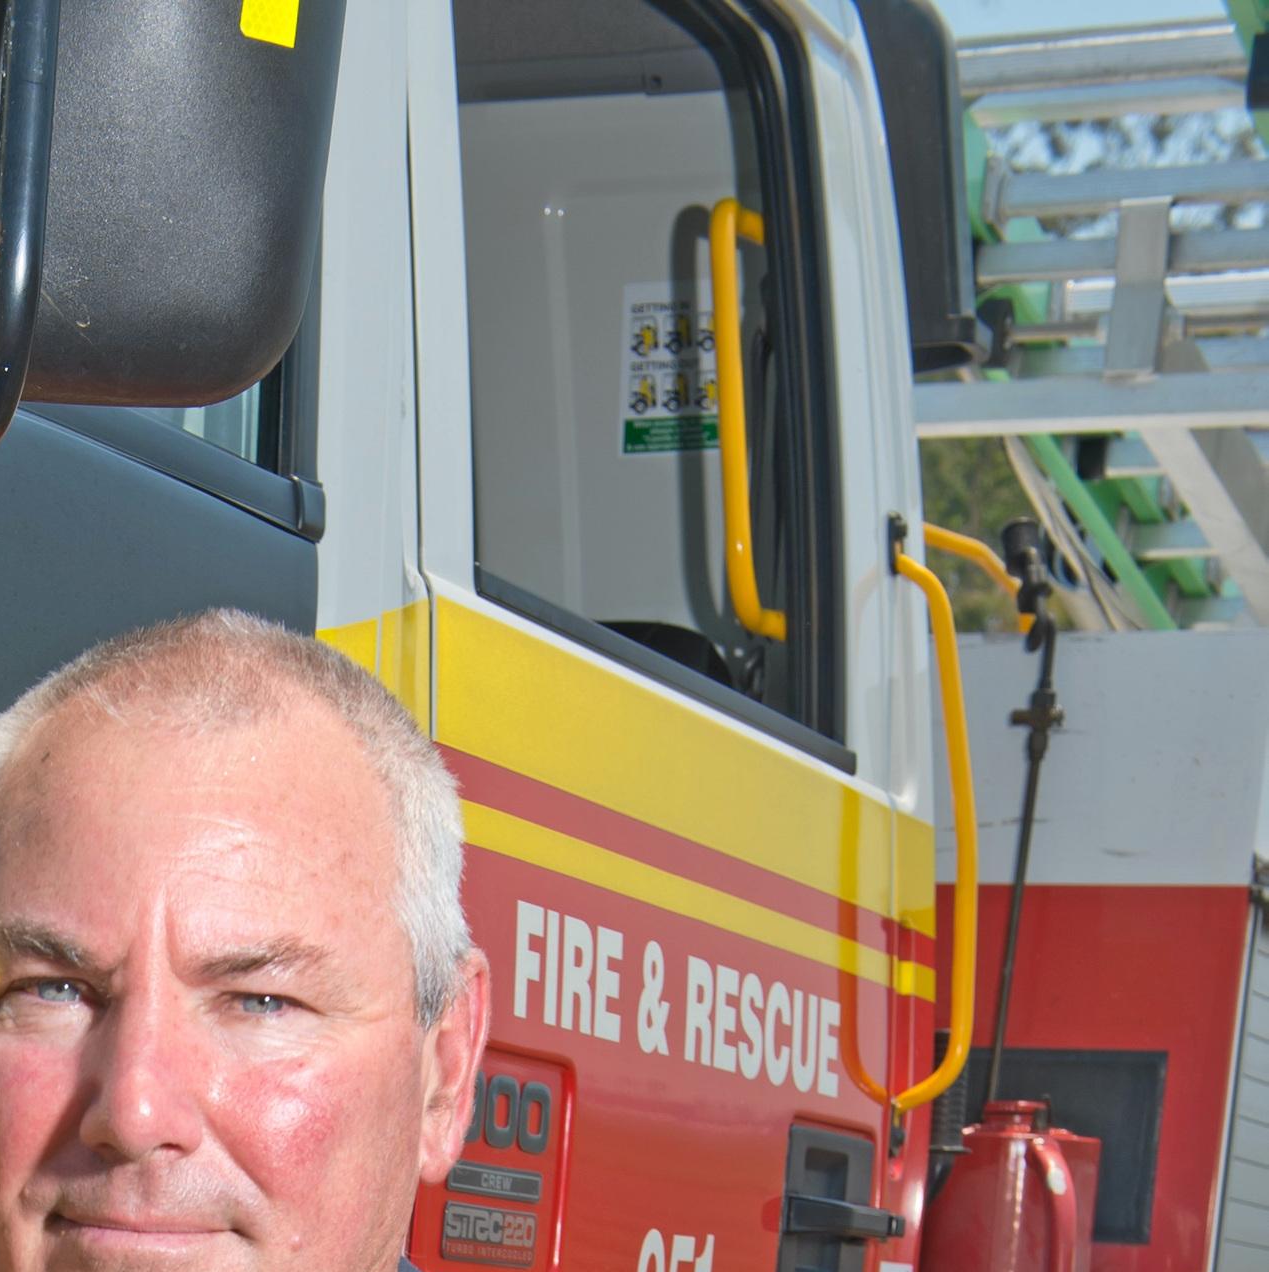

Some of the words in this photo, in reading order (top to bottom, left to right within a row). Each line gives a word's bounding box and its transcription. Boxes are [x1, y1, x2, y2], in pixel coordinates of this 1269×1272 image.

[514, 900, 623, 1043] FIRE
[637, 940, 670, 1056] &
[685, 955, 840, 1098] RESCUE
[481, 1173, 513, 1192] CREW
[445, 1241, 475, 1256] TURBO
[477, 1244, 533, 1263] INTERCOOLED
